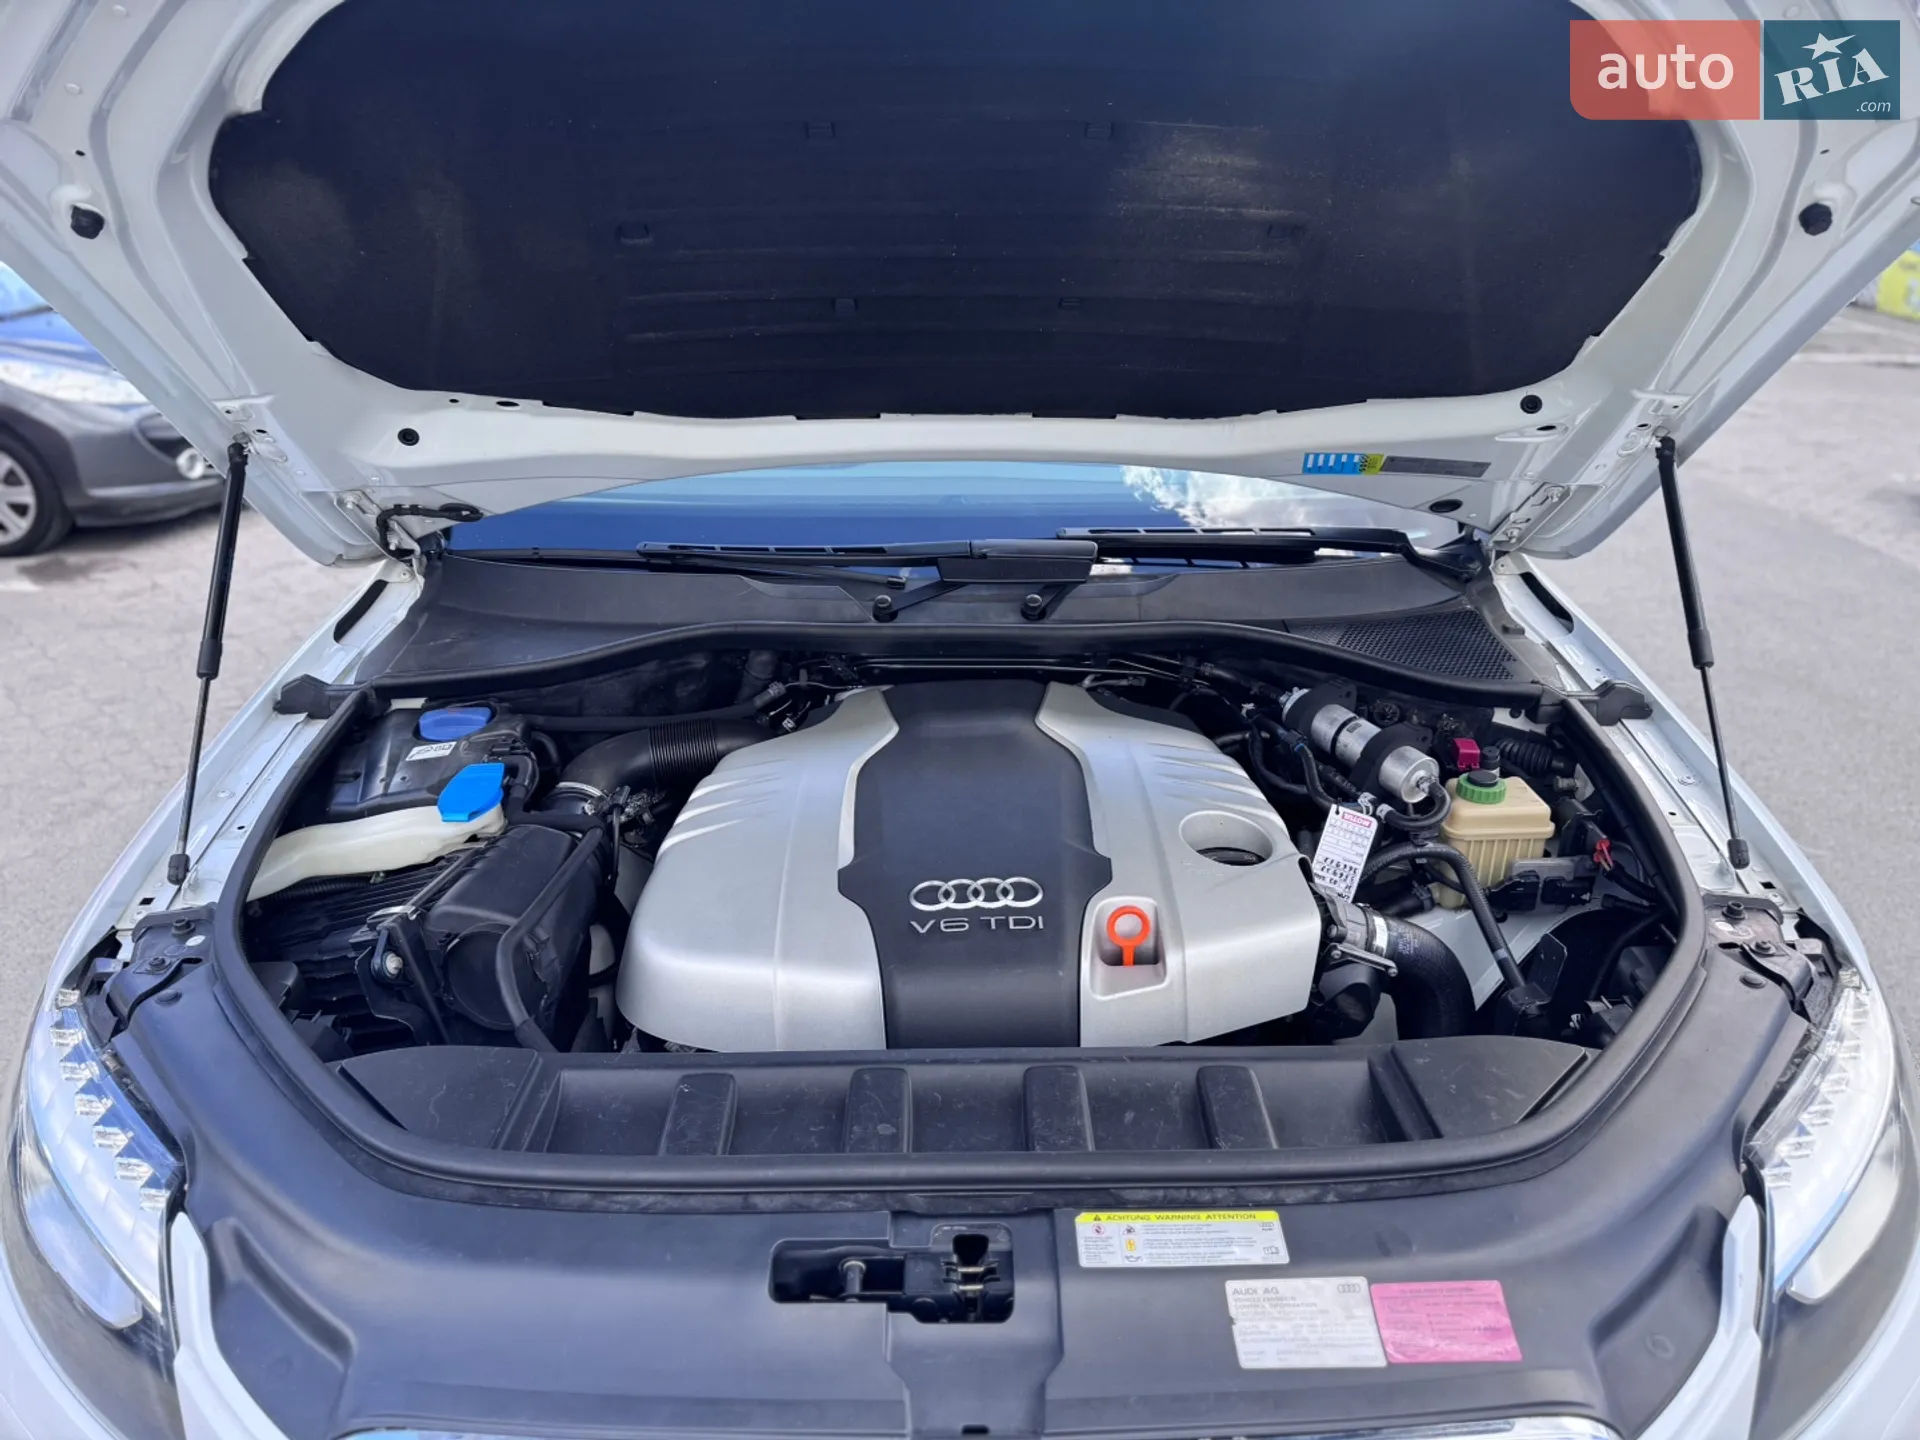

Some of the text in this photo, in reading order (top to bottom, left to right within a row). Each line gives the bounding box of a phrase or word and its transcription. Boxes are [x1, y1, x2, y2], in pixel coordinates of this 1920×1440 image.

[1343, 812, 1371, 828] MOTUL
[909, 915, 1044, 934] V6 TDI
[1106, 1212, 1257, 1221] ACHTUNG WARNING ATTENTION
[1232, 1286, 1280, 1296] AUDI AG
